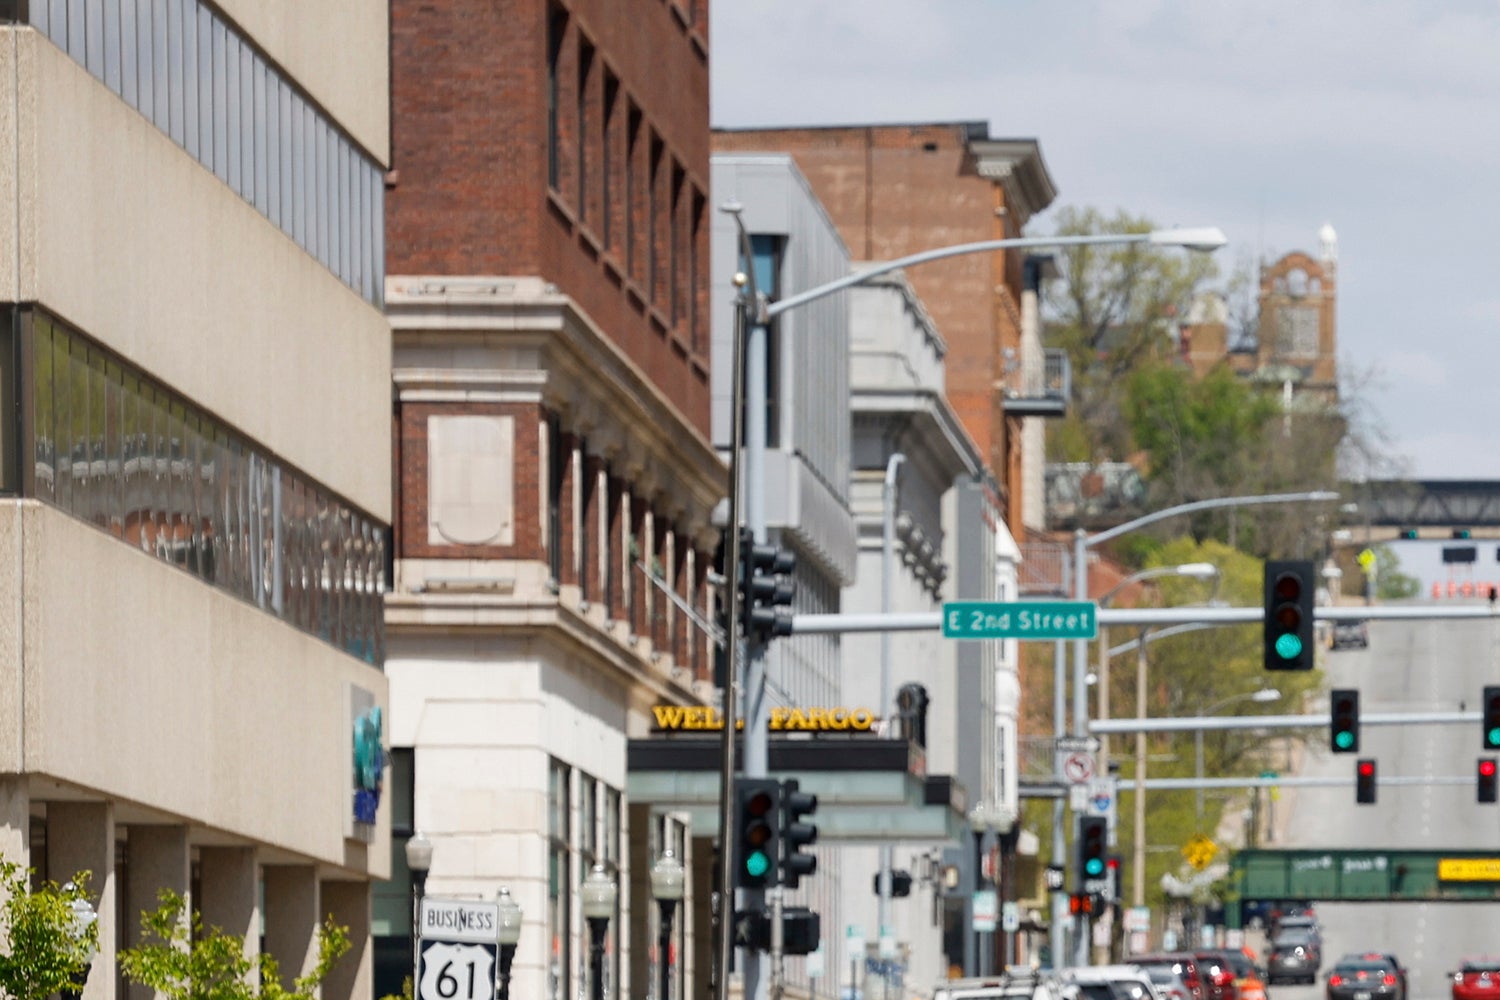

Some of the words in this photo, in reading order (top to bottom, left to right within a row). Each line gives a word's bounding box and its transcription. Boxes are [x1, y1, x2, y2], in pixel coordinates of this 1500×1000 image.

[949, 610, 961, 631] E
[970, 610, 1011, 631] 2nd
[1018, 610, 1088, 631] Street
[652, 705, 745, 730] WEL
[769, 706, 875, 731] FARGO
[426, 907, 493, 931] BUSINESS
[435, 960, 474, 1000] 61
